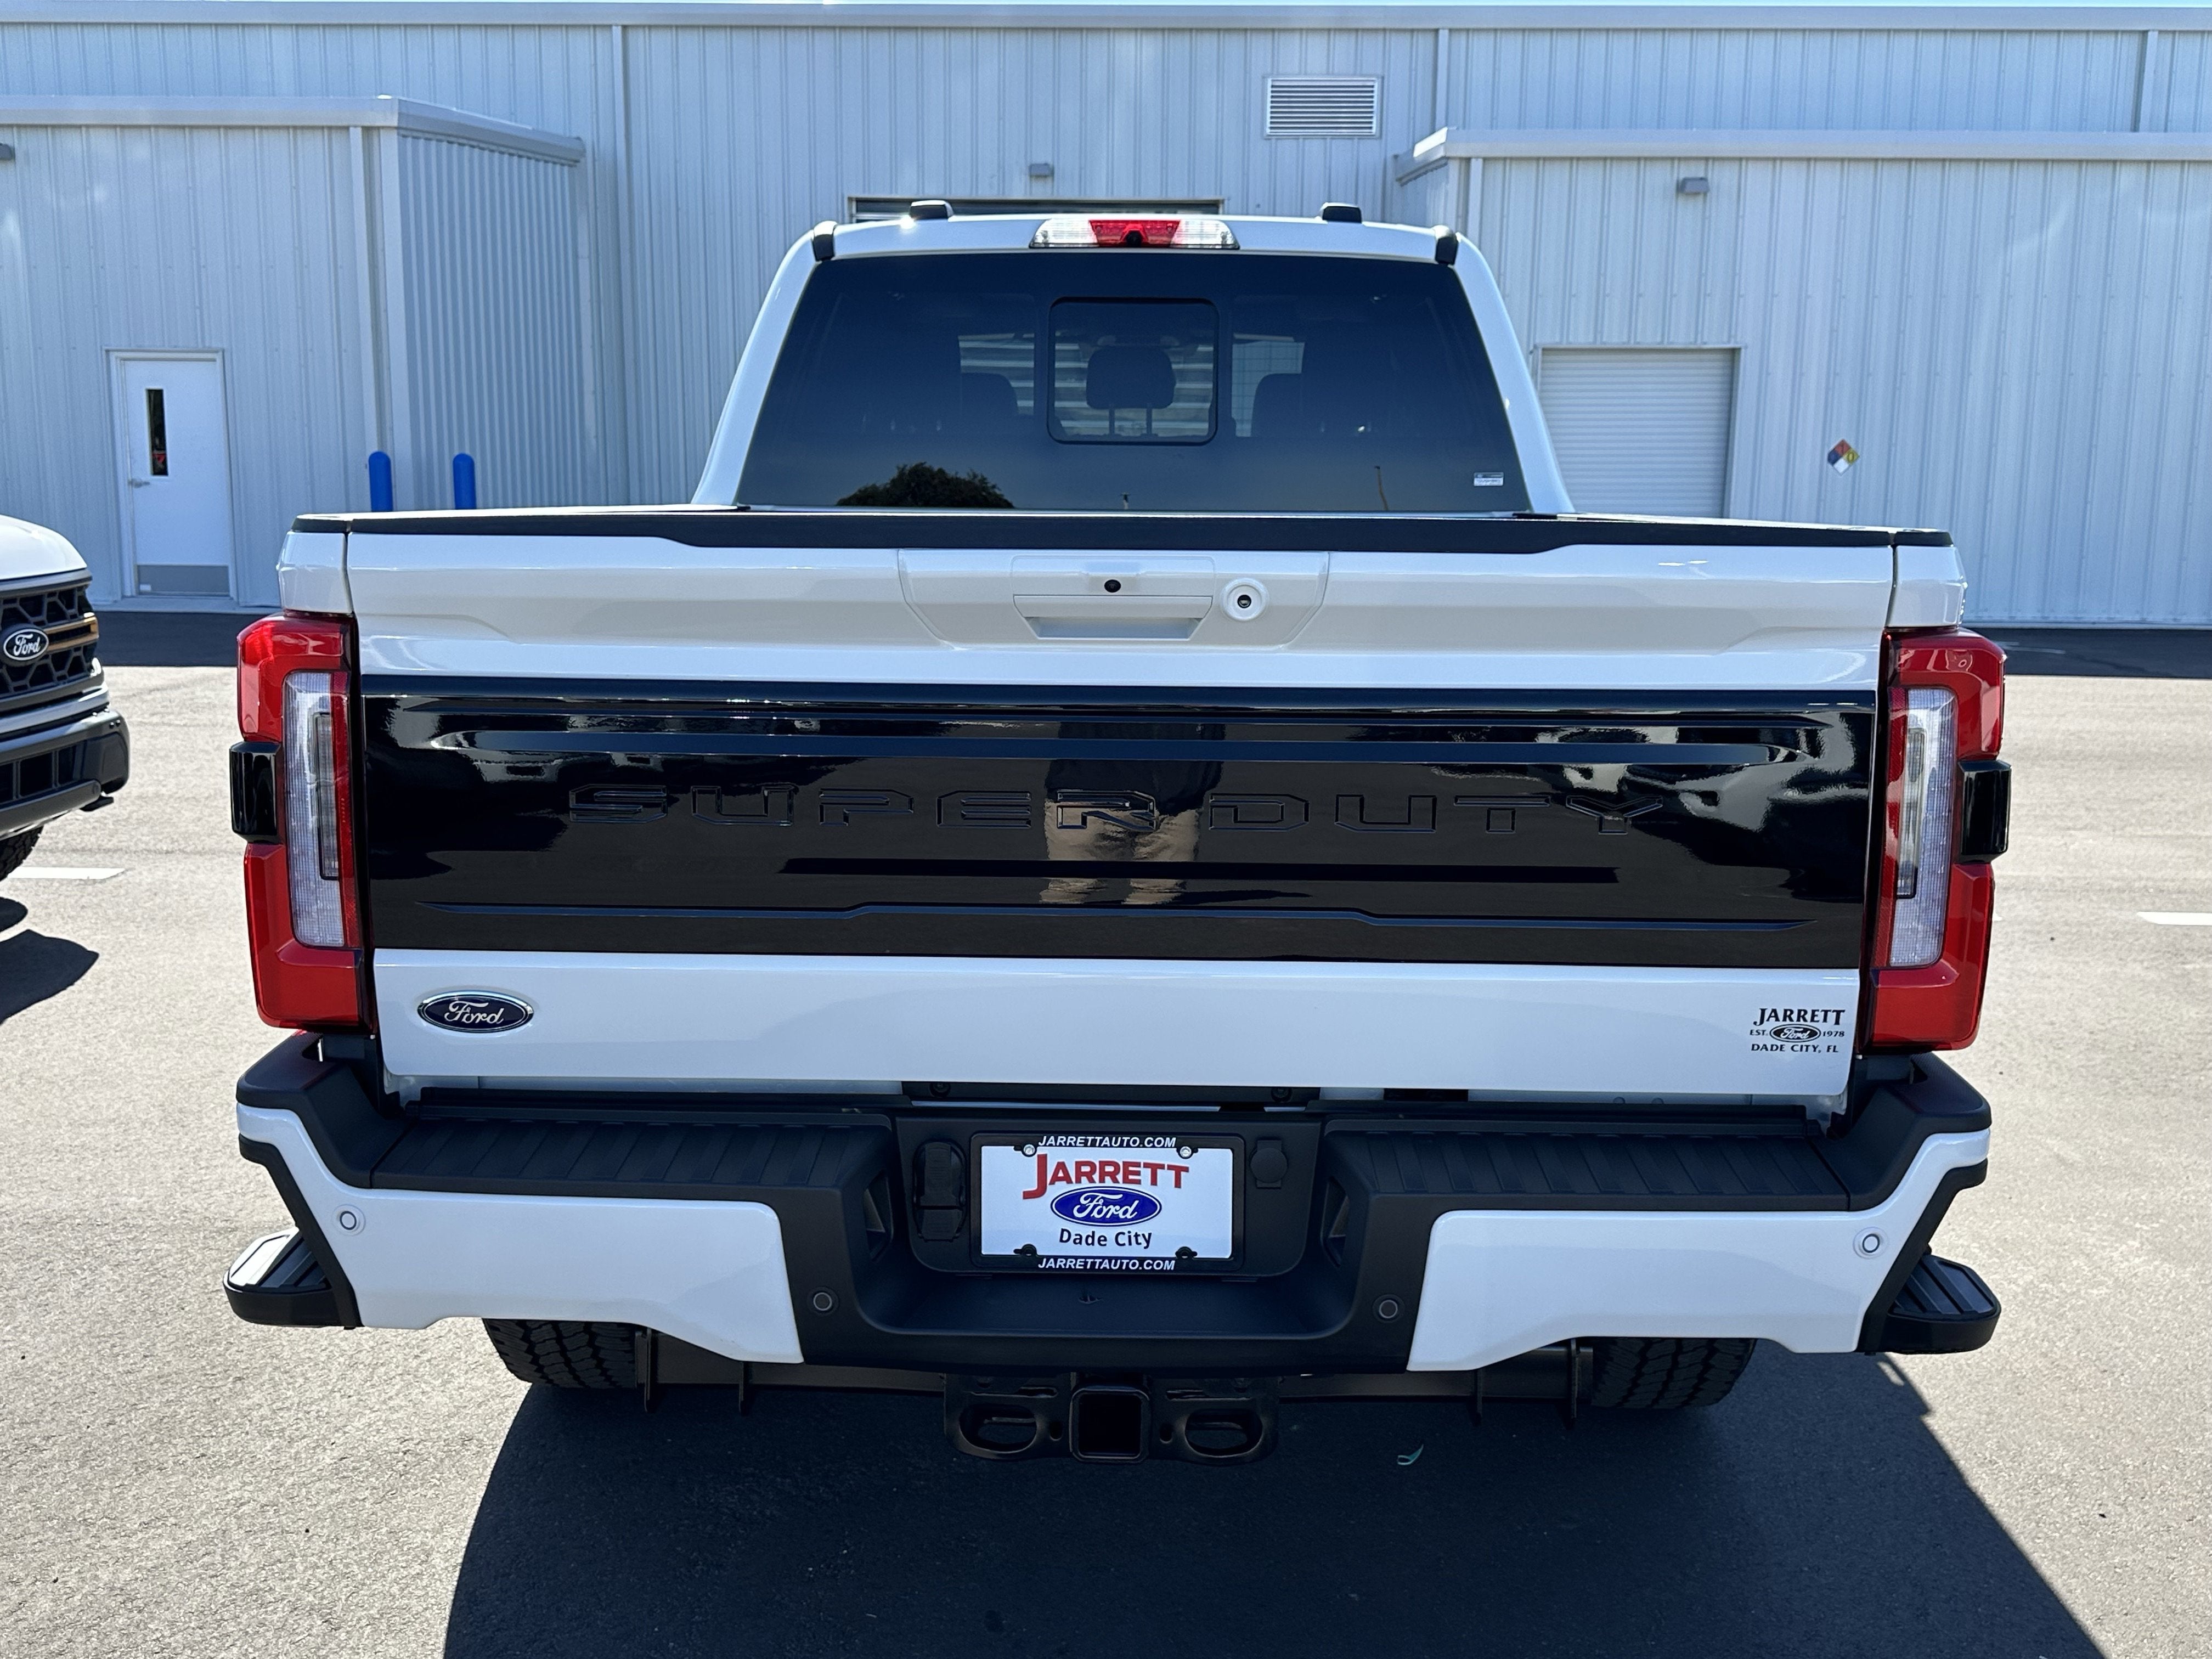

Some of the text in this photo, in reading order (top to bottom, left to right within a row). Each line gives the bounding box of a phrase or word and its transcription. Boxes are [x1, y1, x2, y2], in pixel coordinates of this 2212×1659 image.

[13, 634, 41, 656] Ford
[569, 784, 1663, 834] SUPER DUTY
[444, 1000, 505, 1024] Ford
[1753, 1008, 1846, 1026] JARRETT
[1781, 1028, 1810, 1039] Ford
[1751, 1043, 1786, 1052] DADE
[1790, 1044, 1821, 1053] CITY,
[1038, 1136, 1176, 1148] JARRETTAUTO.COM
[1022, 1153, 1189, 1200] JARRETT
[1073, 1193, 1139, 1219] Ford
[1059, 1228, 1153, 1249] Dade City
[1038, 1258, 1175, 1271] JARRETTAUTO.COM
